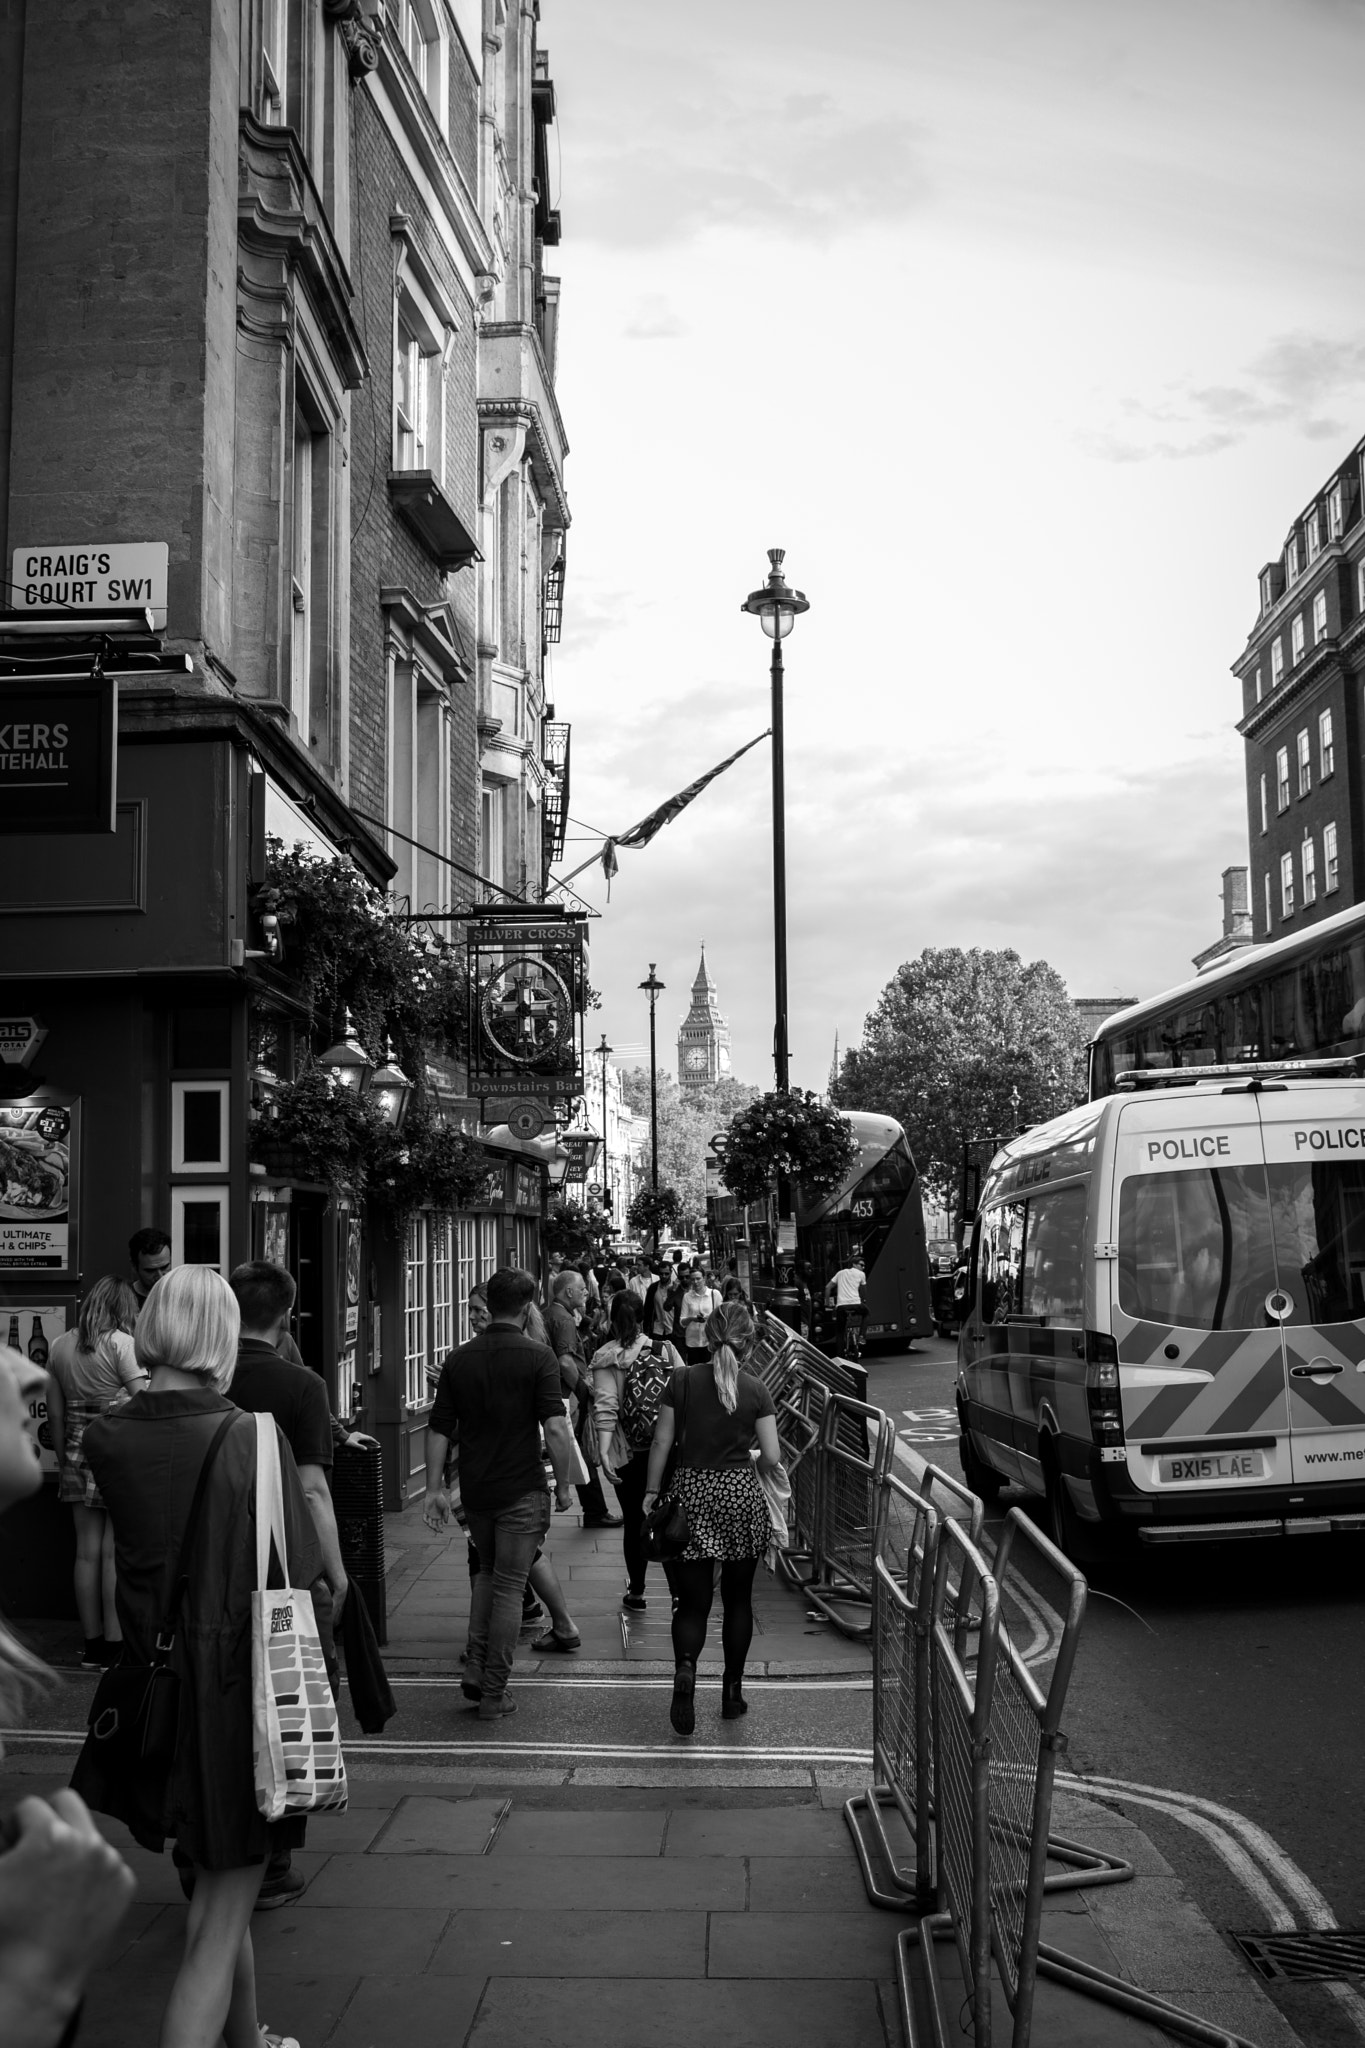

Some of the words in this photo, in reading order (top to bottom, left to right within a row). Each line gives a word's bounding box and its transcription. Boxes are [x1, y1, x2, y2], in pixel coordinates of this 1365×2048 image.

[25, 553, 111, 578] CRAIG'S
[25, 581, 98, 605] COURT
[107, 578, 153, 602] SW1
[474, 929, 523, 940] SILVER
[528, 928, 576, 939] CROSS
[471, 1081, 550, 1093] Downstairs
[556, 1081, 581, 1091] Bar
[1147, 1135, 1231, 1162] POLICE
[852, 1200, 874, 1218] 453
[3, 1230, 52, 1241] ULTIMATE
[8, 1242, 15, 1250] &
[18, 1242, 47, 1250] CHIPS
[1304, 1448, 1365, 1464] www.me
[1171, 1459, 1212, 1479] BX15
[1216, 1455, 1254, 1477] LAE
